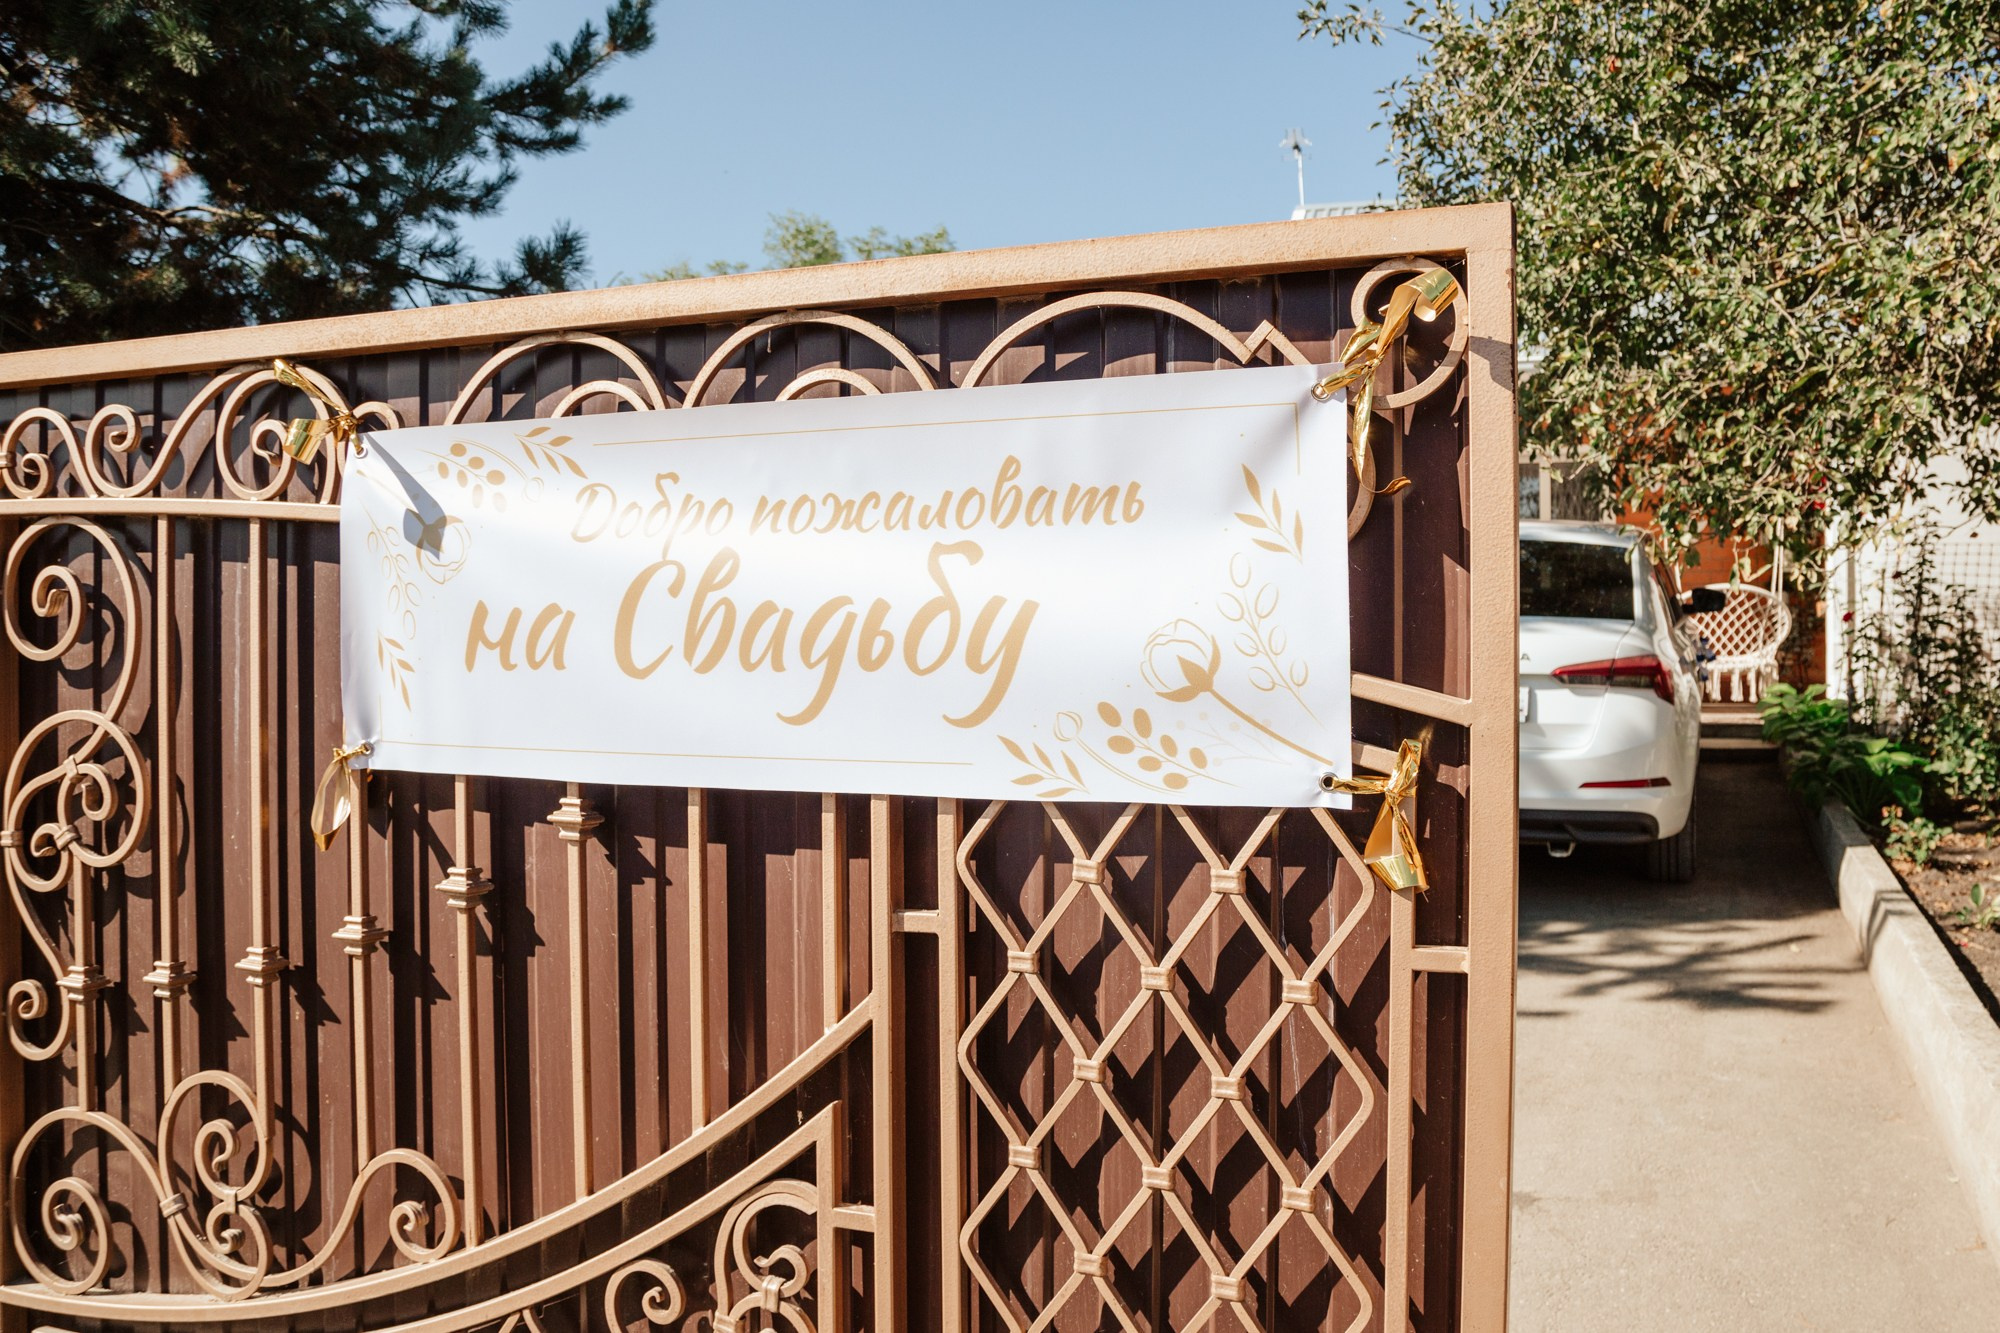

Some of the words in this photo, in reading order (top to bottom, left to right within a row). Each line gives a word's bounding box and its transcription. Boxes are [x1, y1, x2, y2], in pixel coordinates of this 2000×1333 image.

[571, 473, 734, 561] Добро
[749, 456, 1144, 535] пожаловать
[465, 601, 576, 672] на
[614, 541, 1040, 728] Свадьбу
